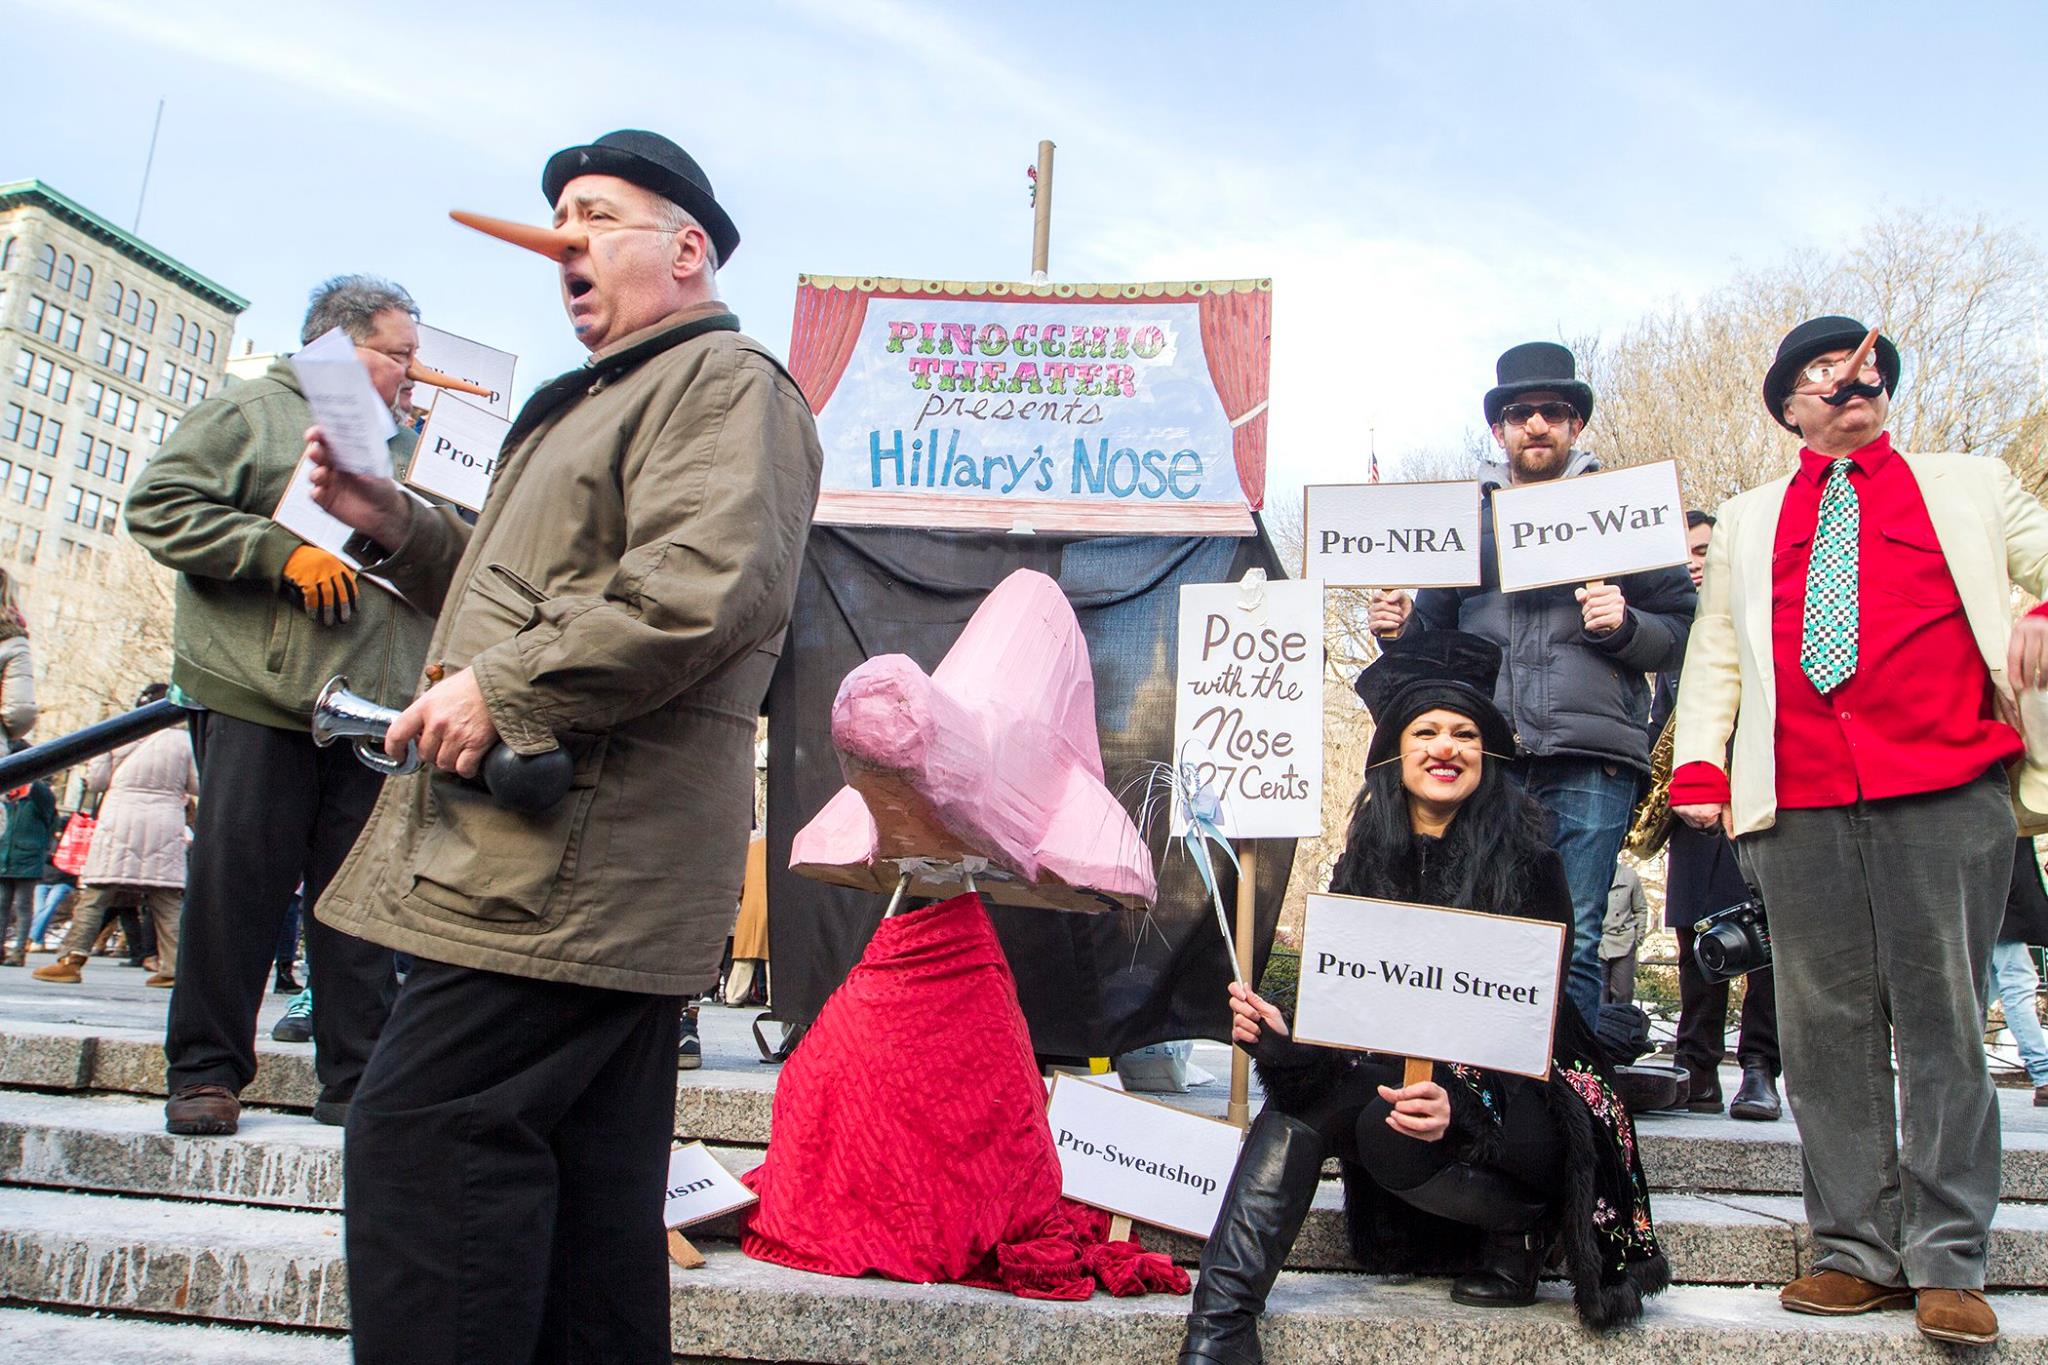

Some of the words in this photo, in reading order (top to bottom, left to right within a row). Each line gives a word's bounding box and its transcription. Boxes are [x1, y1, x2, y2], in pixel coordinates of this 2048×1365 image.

[886, 321, 1166, 358] PINOCCHIO
[909, 358, 1136, 398] THEATER
[913, 393, 1104, 430] presents
[869, 429, 1053, 494] Hillary's
[1072, 438, 1202, 499] Nose
[1320, 527, 1465, 554] Pro-NRA
[1511, 504, 1669, 549] Pro-War
[1202, 614, 1306, 662] Pose
[1188, 663, 1247, 698] with
[1251, 662, 1303, 701] the
[1193, 706, 1293, 760] Nose
[1239, 764, 1309, 801] Cents
[1317, 952, 1442, 990] Pro-Wall
[1452, 971, 1539, 1005] Street
[1057, 1128, 1217, 1195] Pro-Sweatshop
[665, 1178, 714, 1200] ism
